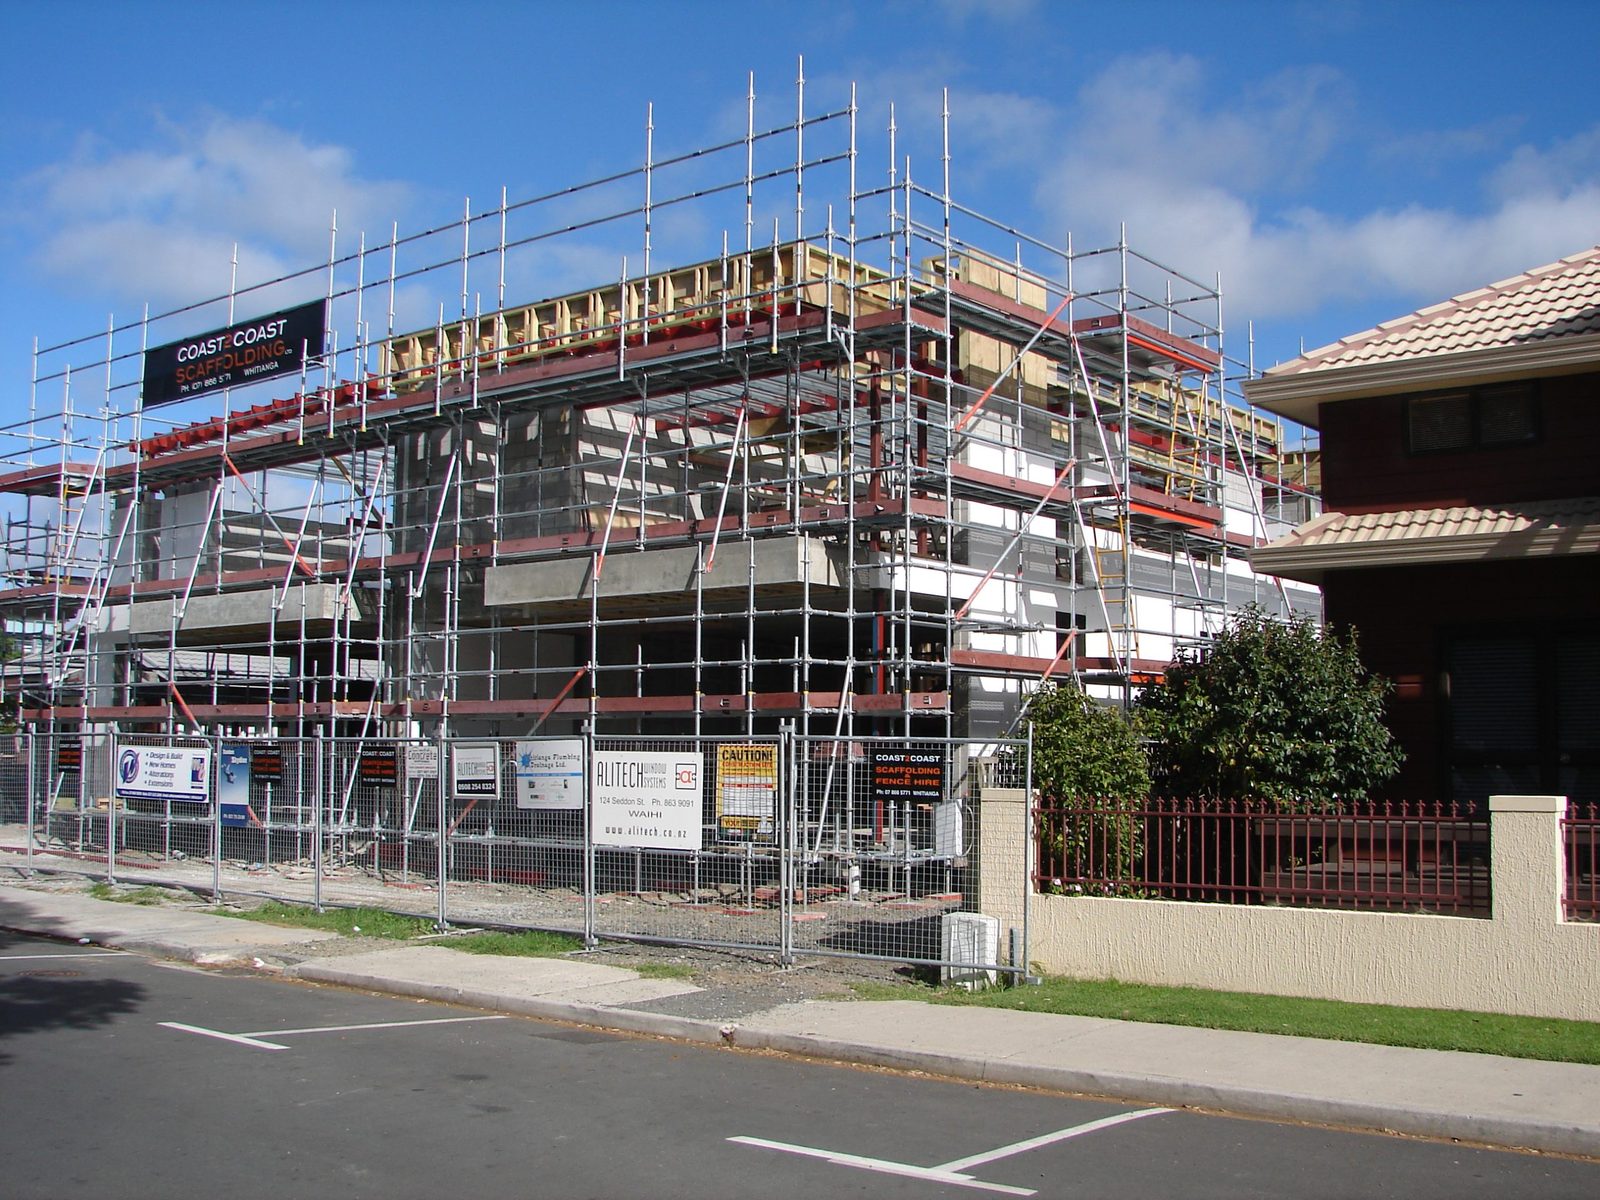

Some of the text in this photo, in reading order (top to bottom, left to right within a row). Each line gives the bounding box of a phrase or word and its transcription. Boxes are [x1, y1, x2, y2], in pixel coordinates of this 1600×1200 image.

[176, 340, 285, 383] SCAFFOLDING
[244, 361, 279, 377] WHITIANGA
[149, 752, 165, 760] Design
[170, 752, 183, 760] Build
[553, 753, 580, 761] Plumbing
[722, 750, 773, 762] CAUTION!
[644, 762, 667, 774] WINDOW
[875, 766, 940, 775] SCAFFOLDING
[597, 761, 644, 788] ALITECH
[643, 777, 667, 789] SYSTEMS
[612, 797, 635, 806] Seddon
[664, 799, 676, 807] 863
[628, 810, 662, 818] WAIHI
[605, 826, 687, 838] www.alitech.co.nz
